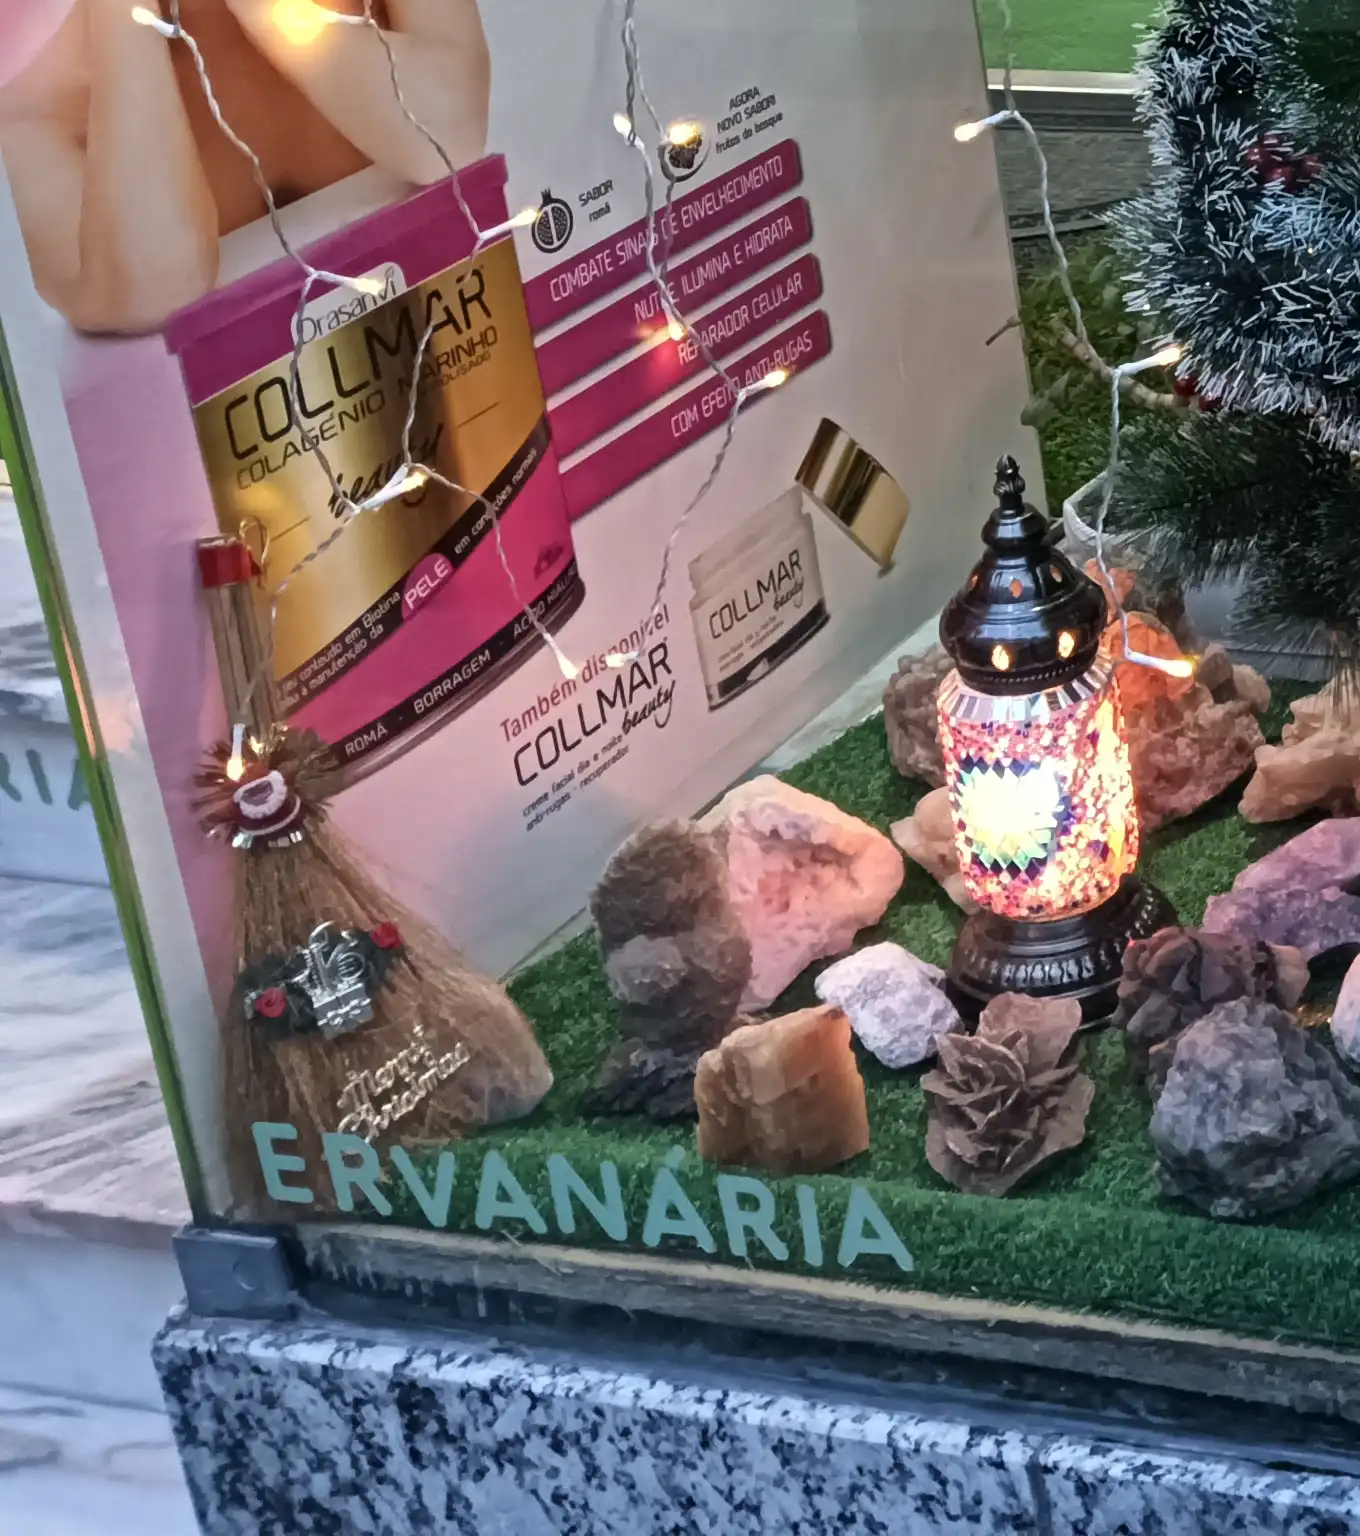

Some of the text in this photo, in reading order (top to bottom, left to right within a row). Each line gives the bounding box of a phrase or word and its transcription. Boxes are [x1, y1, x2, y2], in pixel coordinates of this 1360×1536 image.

[717, 111, 742, 134] NOVO
[729, 86, 760, 112] AGORA
[578, 179, 615, 208] SABOR
[549, 248, 614, 303] COMBATE
[681, 155, 784, 231] ENVELHECIMENTO
[634, 215, 795, 324] NUTE ILUMINA E HIDRATA
[751, 271, 804, 320] CELULAR
[224, 267, 493, 461] COLLMAR
[670, 404, 700, 438] COM
[404, 558, 450, 610] PELE
[709, 549, 803, 640] COLLMAR
[345, 722, 388, 756] ROMÃ
[412, 649, 491, 715] BORRAGEM
[500, 674, 577, 742] Também
[514, 641, 673, 787] COLLMAR
[622, 679, 676, 736] beauty
[251, 1120, 916, 1272] ERVANÁRIA
